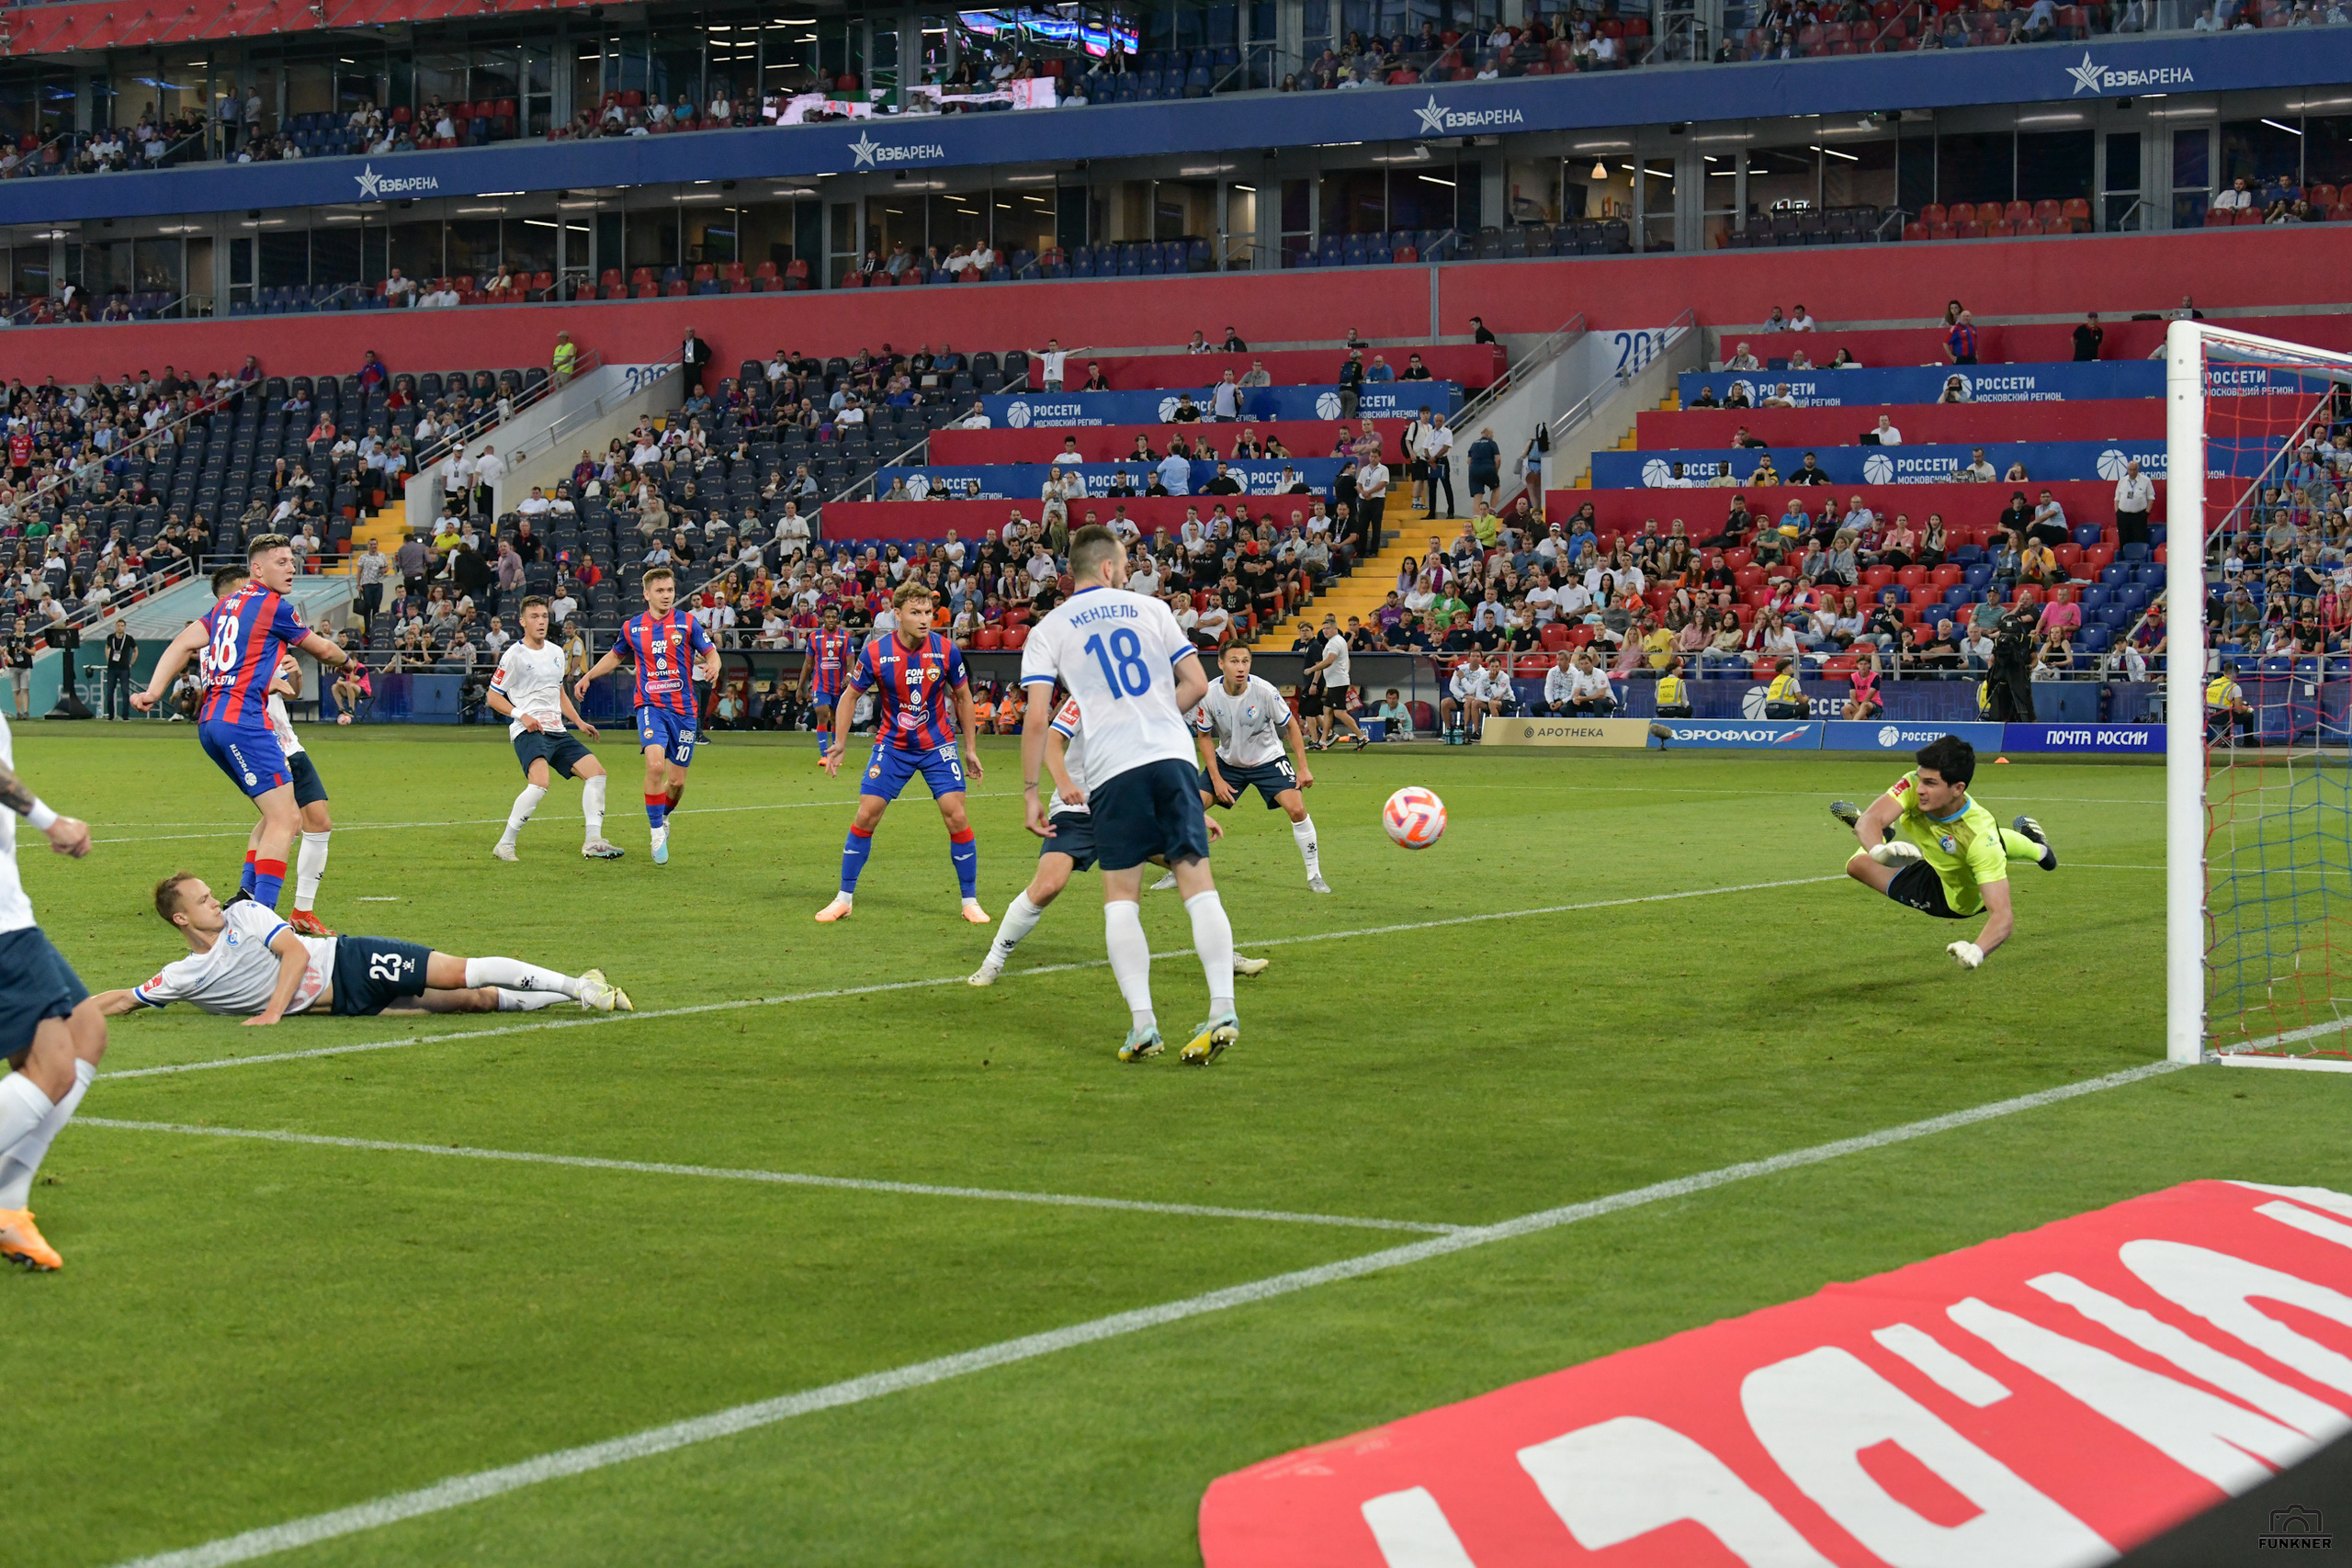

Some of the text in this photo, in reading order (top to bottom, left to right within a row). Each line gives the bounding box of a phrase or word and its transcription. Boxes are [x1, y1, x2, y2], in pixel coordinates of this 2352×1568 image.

[2104, 67, 2194, 87] ВЭБАРЕНА
[1446, 108, 1523, 128] ВЭБАРЕНА
[876, 144, 944, 162] ВЭБАРЕНА
[379, 176, 439, 193] ВЭБАРЕНА
[1759, 383, 1815, 396] РОСЕТИ
[1976, 377, 2035, 390] РОССЕТИ
[1360, 395, 1396, 407] ССЕТИ
[1812, 398, 1840, 407] РЕГИОН
[1976, 391, 2062, 402] МОСКОВСКИЙ РЕГИОН
[1034, 404, 1081, 416] РОССЕТИ
[1034, 418, 1102, 427] МОСКОВСКИЙ РЕГИОН
[1897, 458, 1959, 472] РОССЕТИ
[1089, 475, 1138, 487] РОССТИ
[1070, 604, 1139, 628] МЕНДЕЛЬ
[209, 615, 240, 671] 38
[652, 646, 668, 654] BET
[1084, 627, 1151, 700] 18
[647, 669, 681, 677] APOTHEKA
[905, 669, 924, 677] FON
[906, 676, 925, 684] BET
[1537, 728, 1604, 738] APOTHEKA
[1668, 729, 1779, 742] АЭРОФЛОТ
[2046, 730, 2148, 746] ПОЧТА РОССИИ
[229, 743, 250, 773] РОССЕТИ
[675, 745, 690, 762] 10
[951, 761, 962, 781] 9
[1274, 760, 1295, 776] 10
[369, 953, 402, 982] 23
